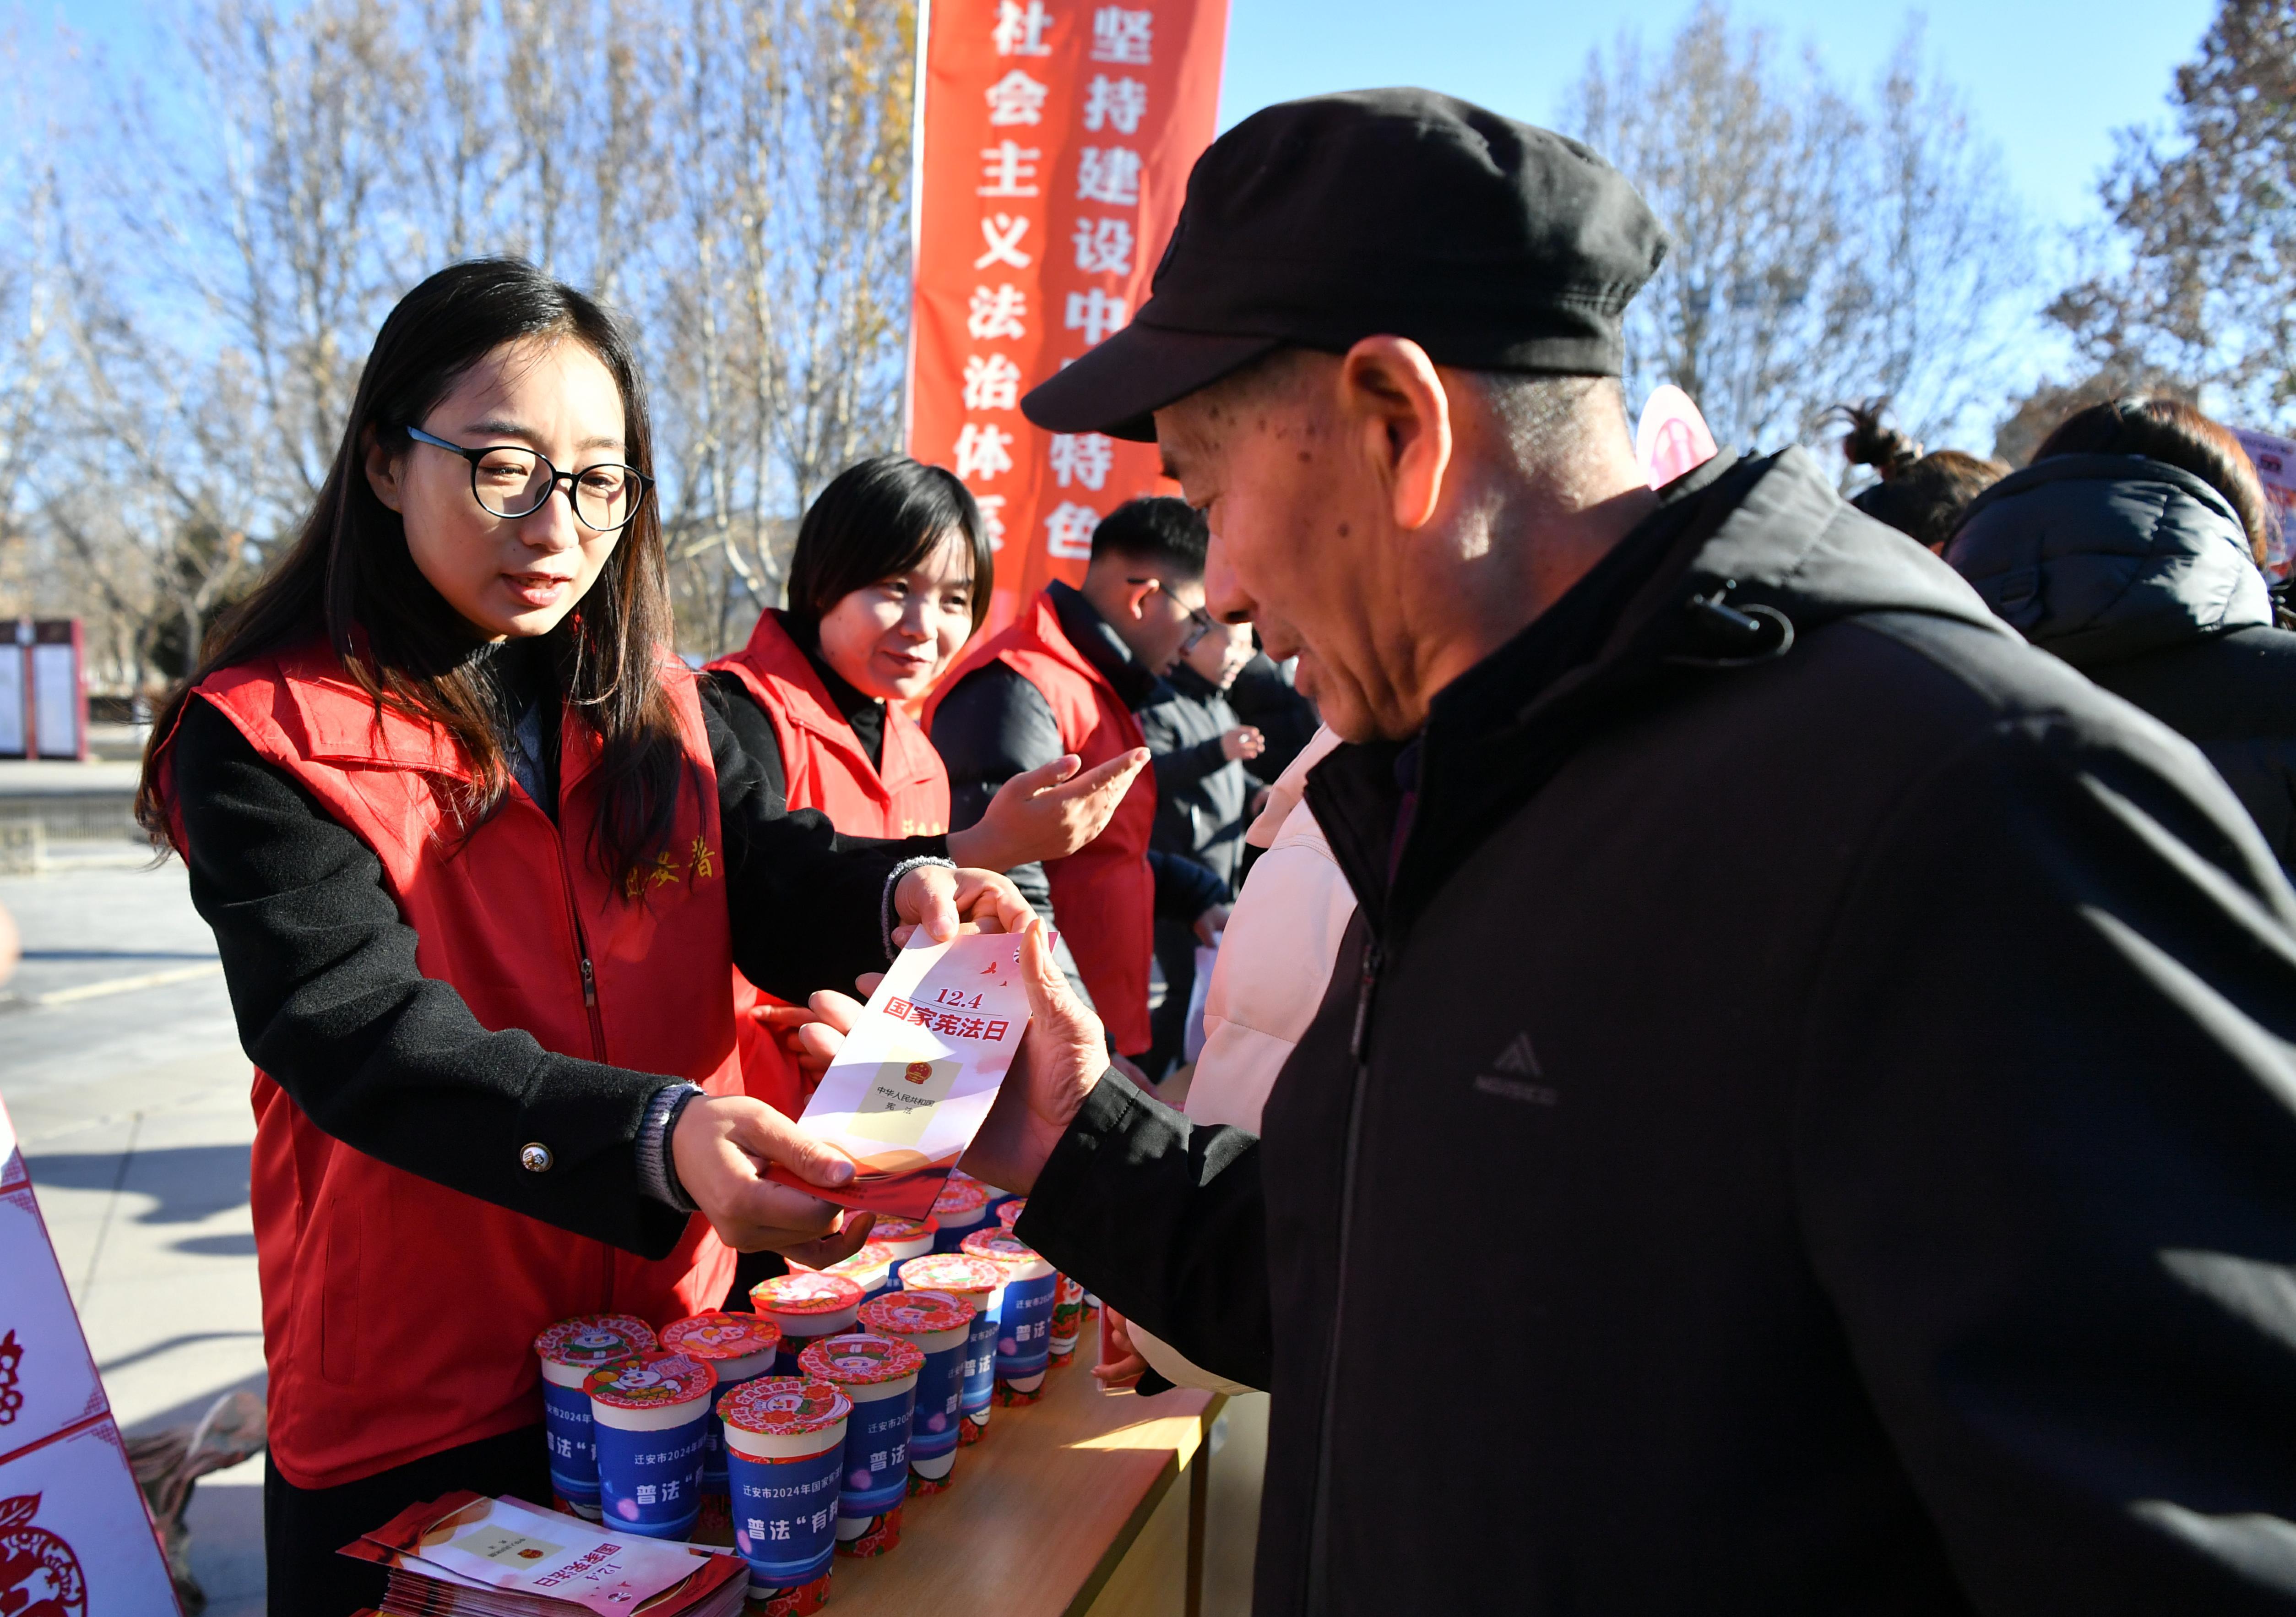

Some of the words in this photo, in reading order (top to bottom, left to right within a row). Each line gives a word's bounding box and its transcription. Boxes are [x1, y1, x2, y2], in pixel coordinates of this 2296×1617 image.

[1044, 5, 1153, 560] 坚持建设中特色
[934, 988, 983, 1009] 12.4
[883, 996, 1010, 1041] 国家宪法日
[877, 1086, 935, 1107] 中华人民共和国
[532, 1543, 623, 1587] 国家宪法日
[584, 1563, 623, 1581] 12.4
